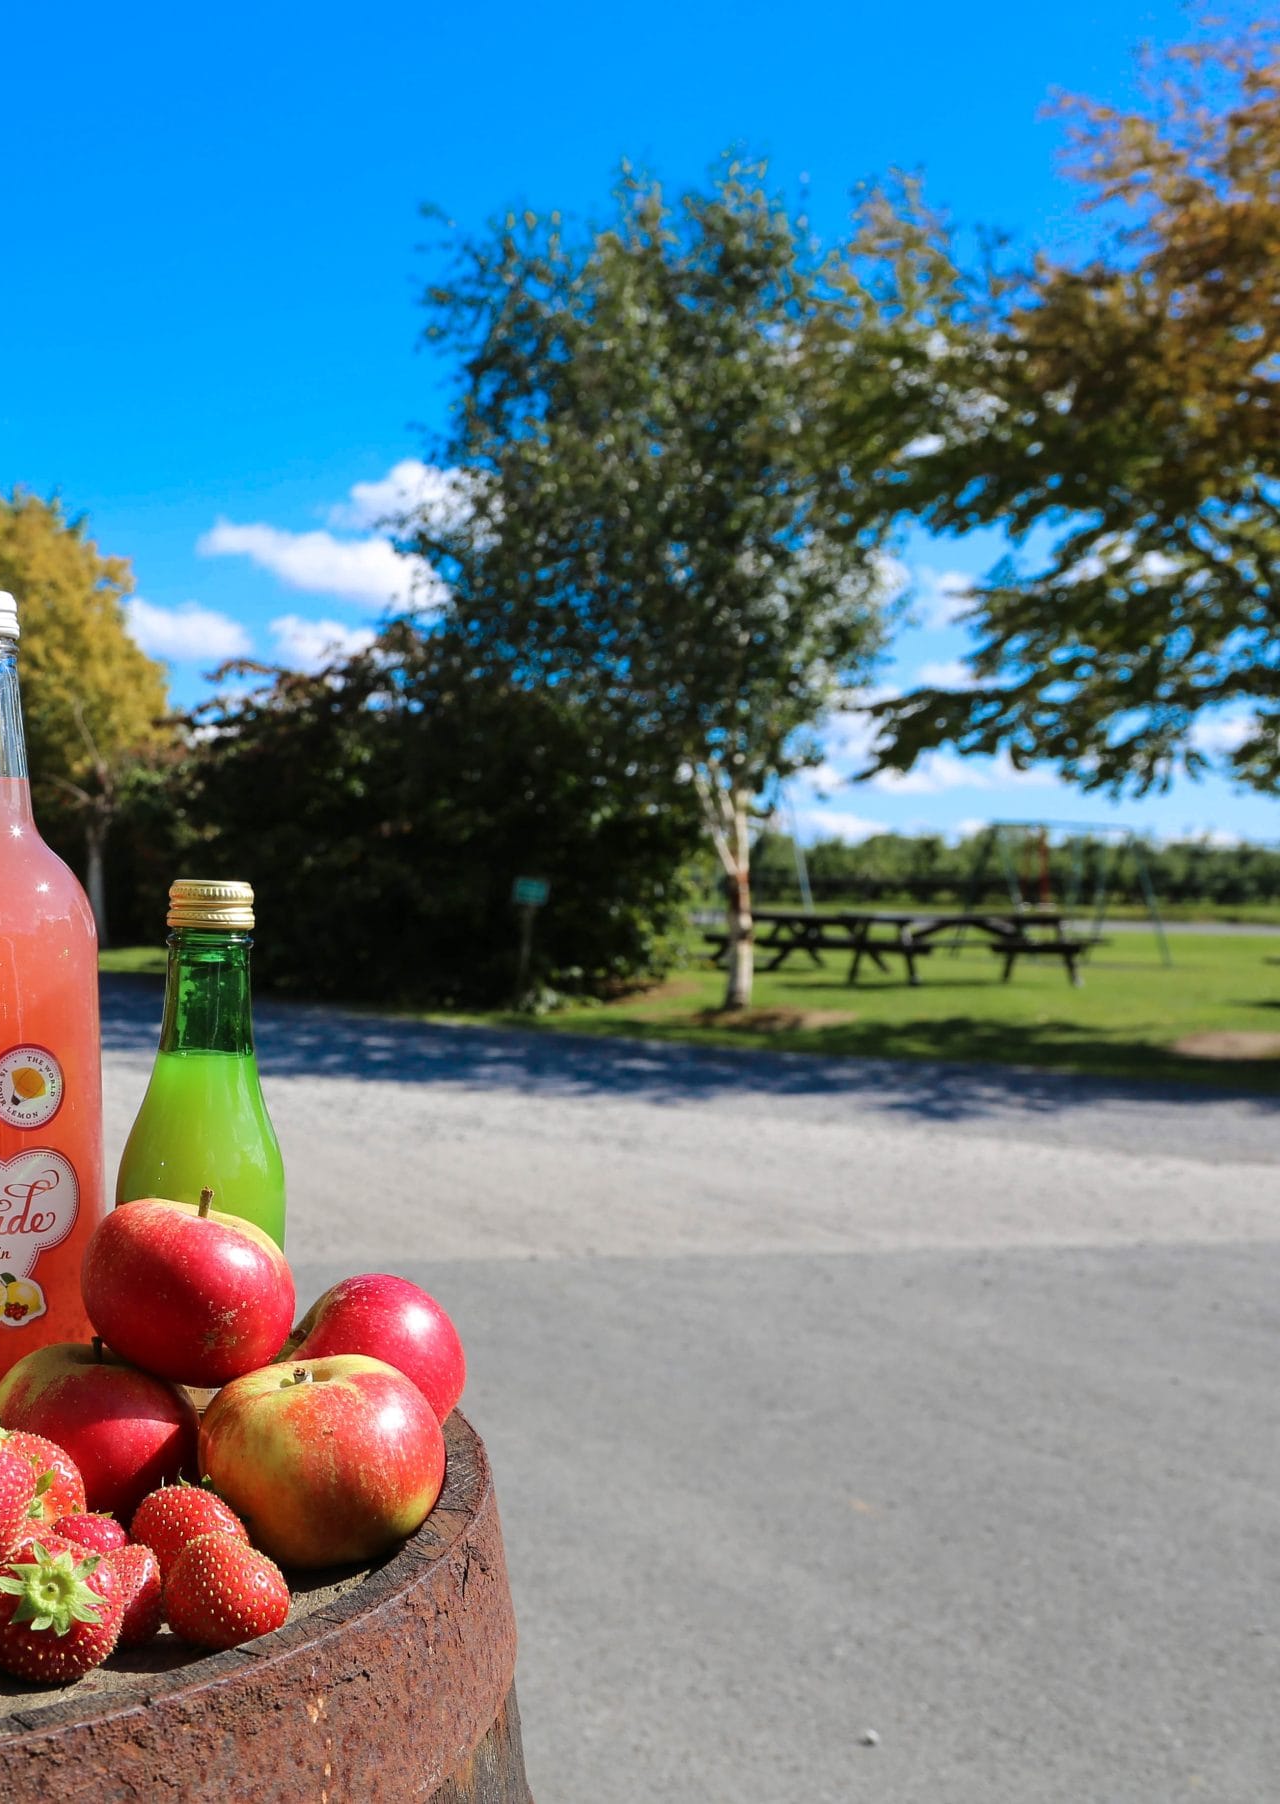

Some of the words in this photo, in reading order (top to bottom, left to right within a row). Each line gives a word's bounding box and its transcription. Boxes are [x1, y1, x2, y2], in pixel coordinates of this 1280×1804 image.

[0, 1068, 8, 1077] IS
[6, 1107, 38, 1119] LEMON
[27, 1056, 44, 1065] THE
[45, 1065, 56, 1097] WORLD
